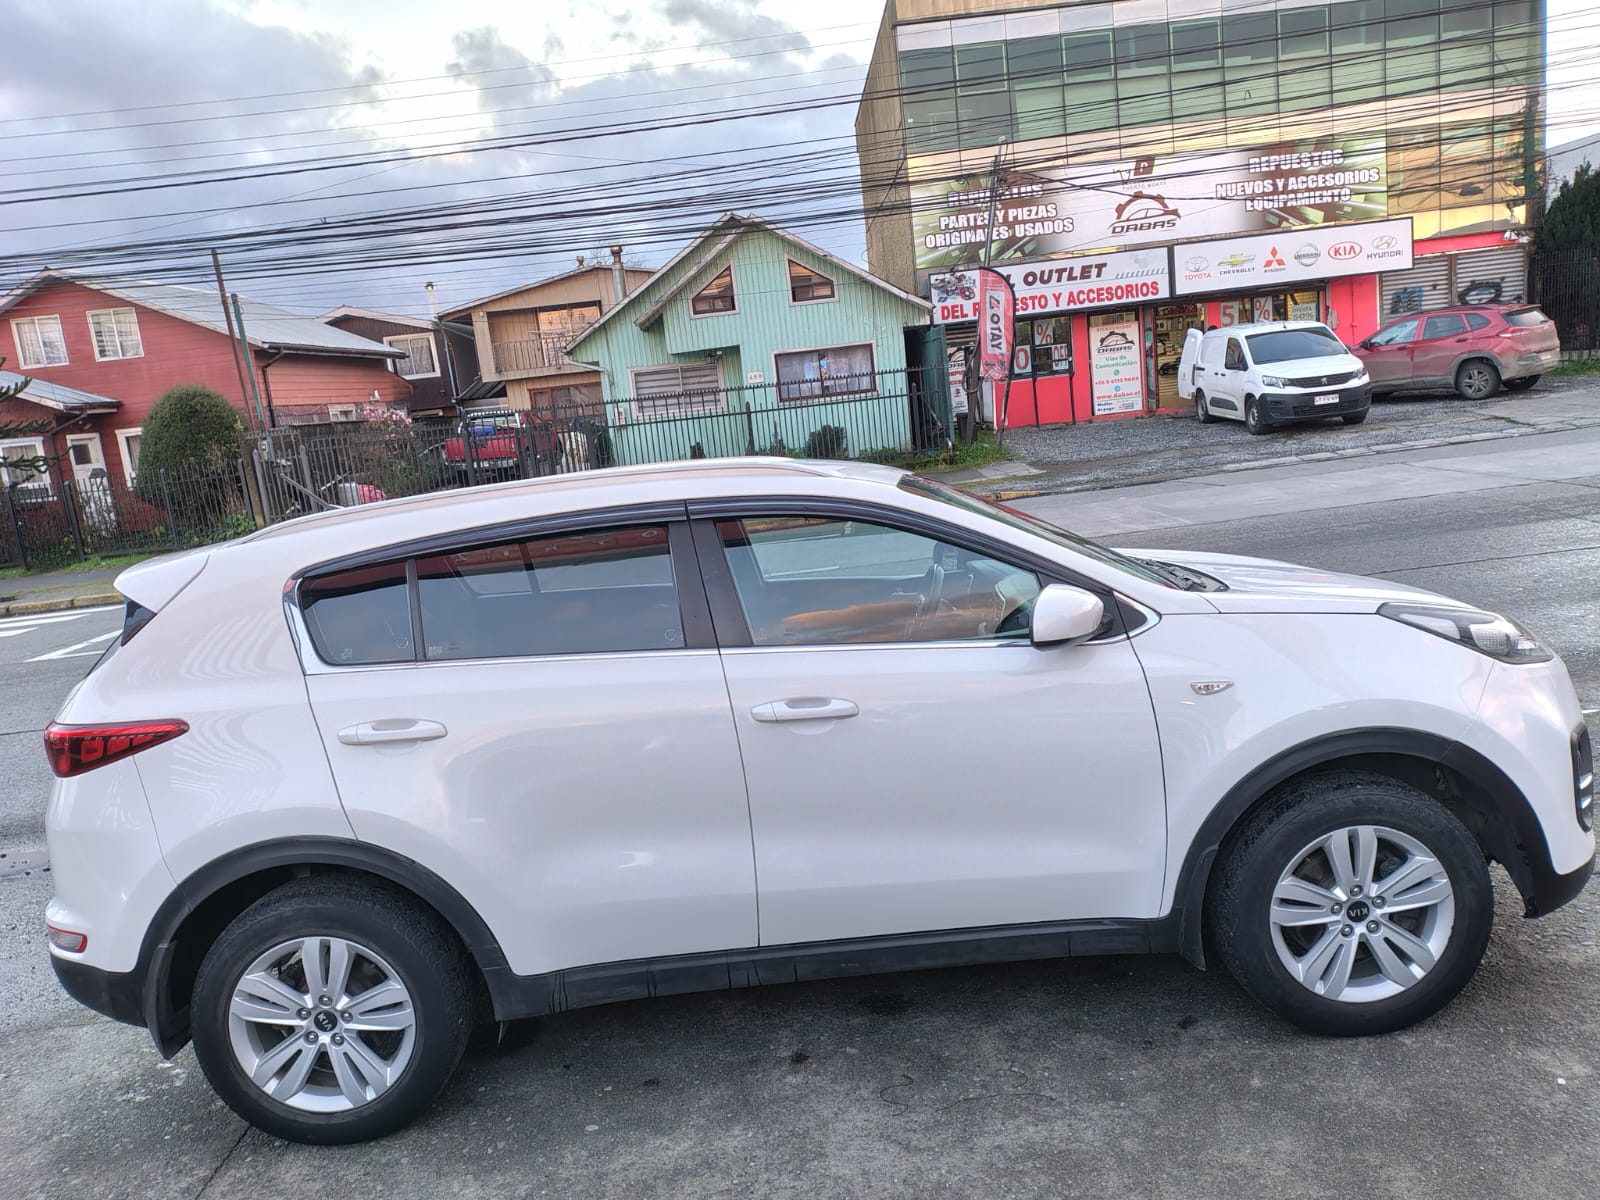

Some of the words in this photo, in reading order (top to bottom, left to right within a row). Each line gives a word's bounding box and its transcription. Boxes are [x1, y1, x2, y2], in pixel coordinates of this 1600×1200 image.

[1248, 149, 1344, 173] REPUESTOS
[1216, 179, 1273, 198] NUEVOS
[1275, 178, 1286, 192] Y
[1287, 168, 1380, 191] ACCESORIOS
[1245, 188, 1351, 212] EQUIPAMIENTO
[939, 211, 991, 230] PARTES
[995, 210, 1005, 223] Y
[1007, 203, 1058, 222] PIEZAS
[1112, 219, 1177, 234] DABAS
[1014, 218, 1075, 238] USADOS
[1333, 245, 1357, 257] KIA
[1366, 249, 1404, 260] HYUNDAI
[1023, 263, 1108, 287] OUTLET
[1184, 272, 1212, 280] TOYOTA
[1219, 267, 1256, 275] CHEVROLET
[941, 302, 969, 321] DEL
[1052, 292, 1063, 308] Y
[1067, 281, 1160, 307] ACCESORIOS
[1348, 906, 1368, 918] KIA
